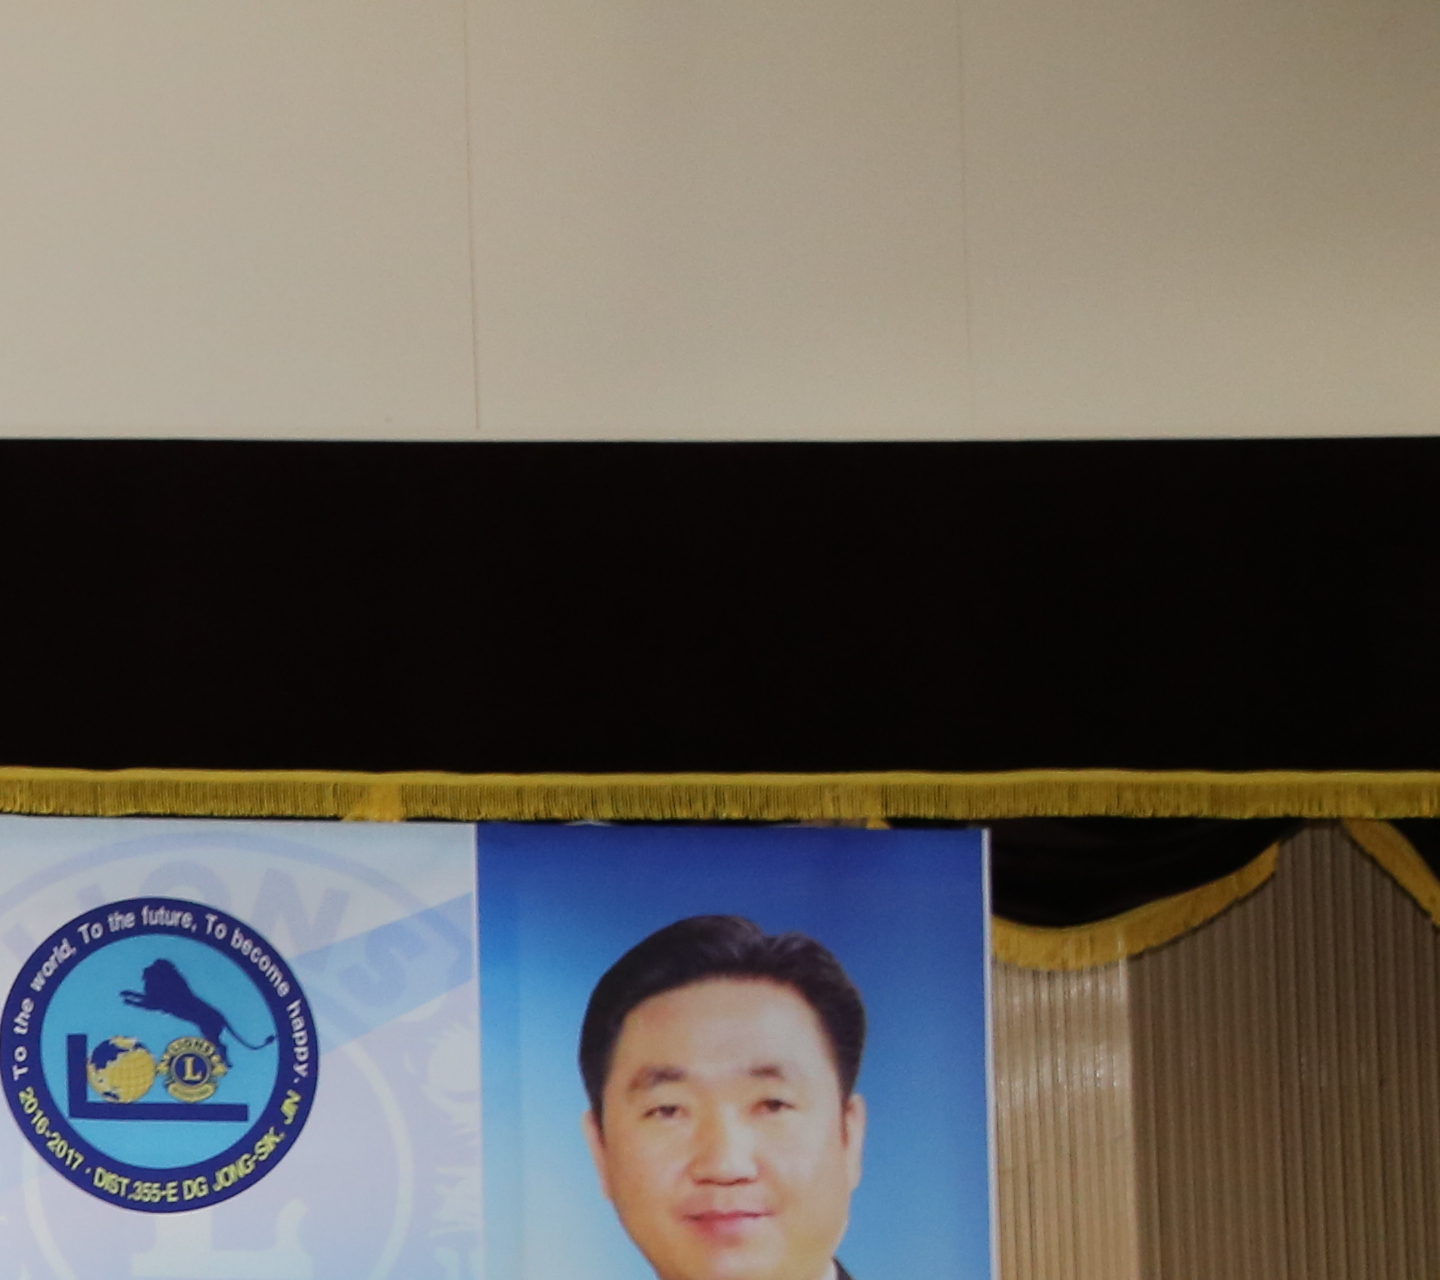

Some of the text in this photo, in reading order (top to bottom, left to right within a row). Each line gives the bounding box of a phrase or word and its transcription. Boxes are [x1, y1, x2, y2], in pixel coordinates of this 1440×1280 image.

[13, 998, 34, 1036] the
[77, 921, 104, 944] To
[108, 910, 136, 933] the
[204, 912, 227, 940] To
[230, 927, 291, 999] become
[18, 1086, 85, 1170] 2016-2017
